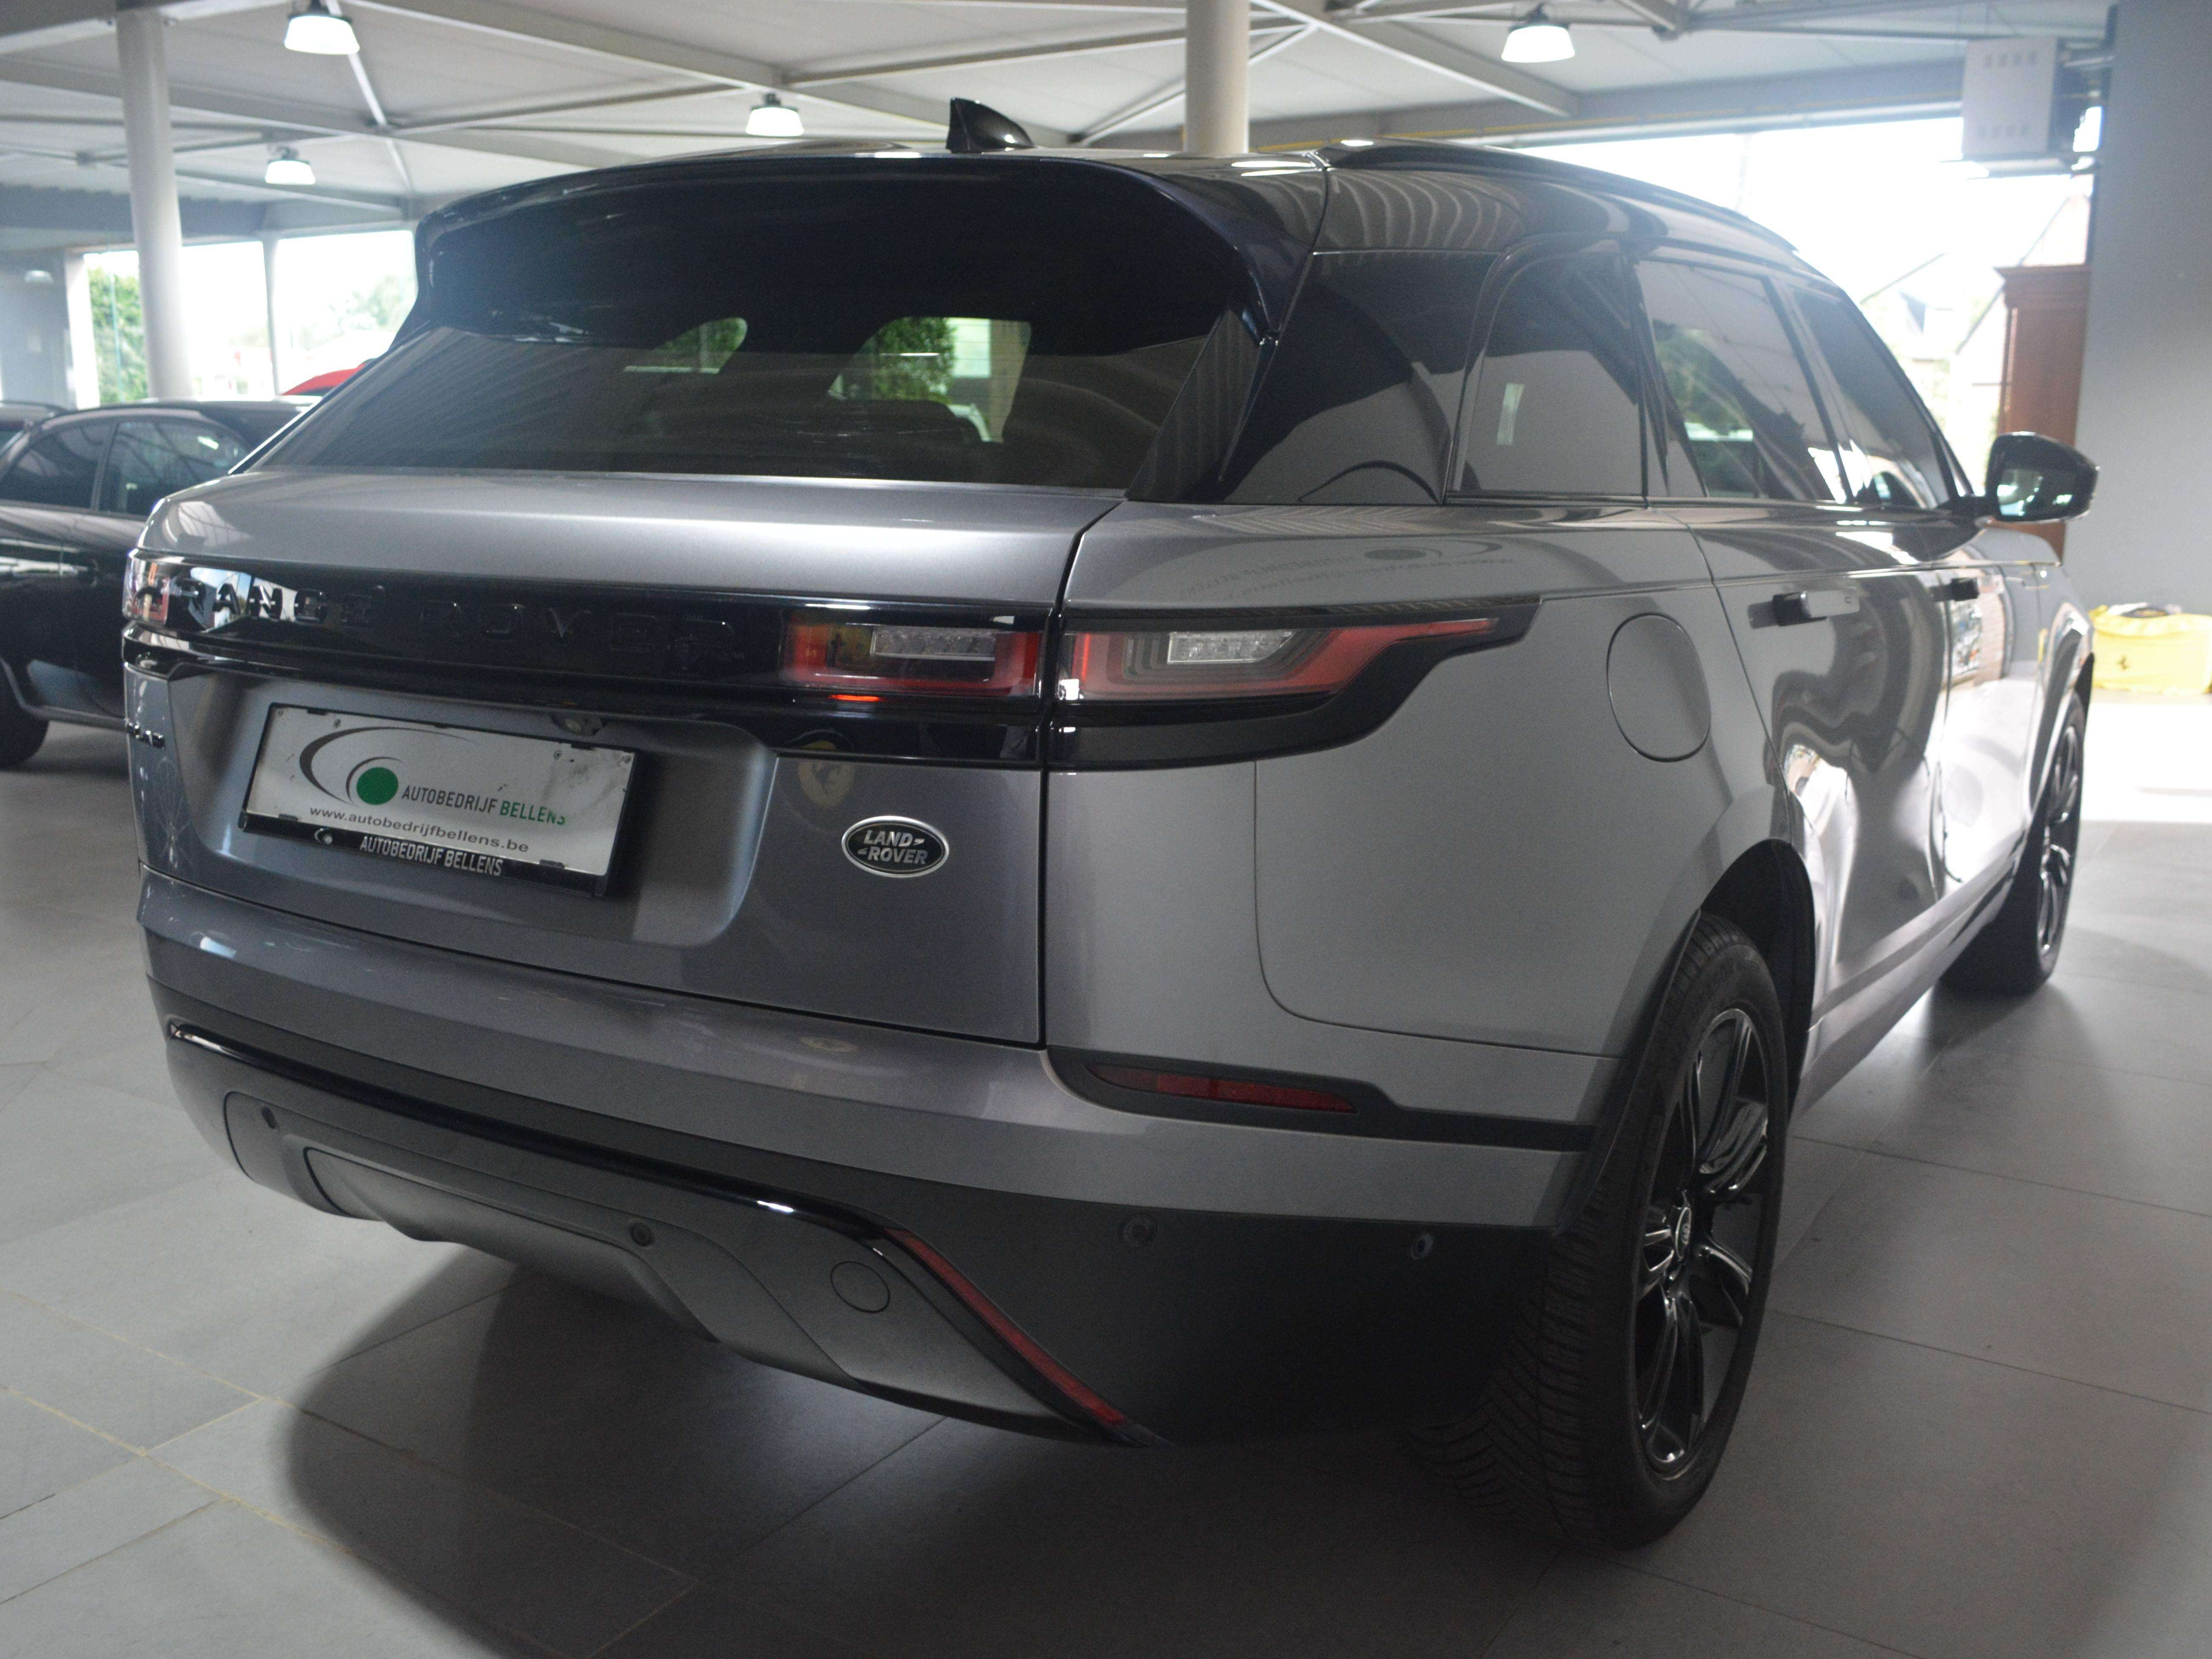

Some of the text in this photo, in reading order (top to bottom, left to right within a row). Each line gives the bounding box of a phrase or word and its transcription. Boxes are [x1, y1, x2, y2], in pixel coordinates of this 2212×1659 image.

[401, 785, 498, 814] AUTOBEDRIJF
[309, 806, 530, 853] www.autobedrijfbellens.be
[863, 830, 913, 847] LAND
[359, 835, 503, 876] AUTOBEDRIJF BELLENS
[867, 846, 928, 865] ROVER
